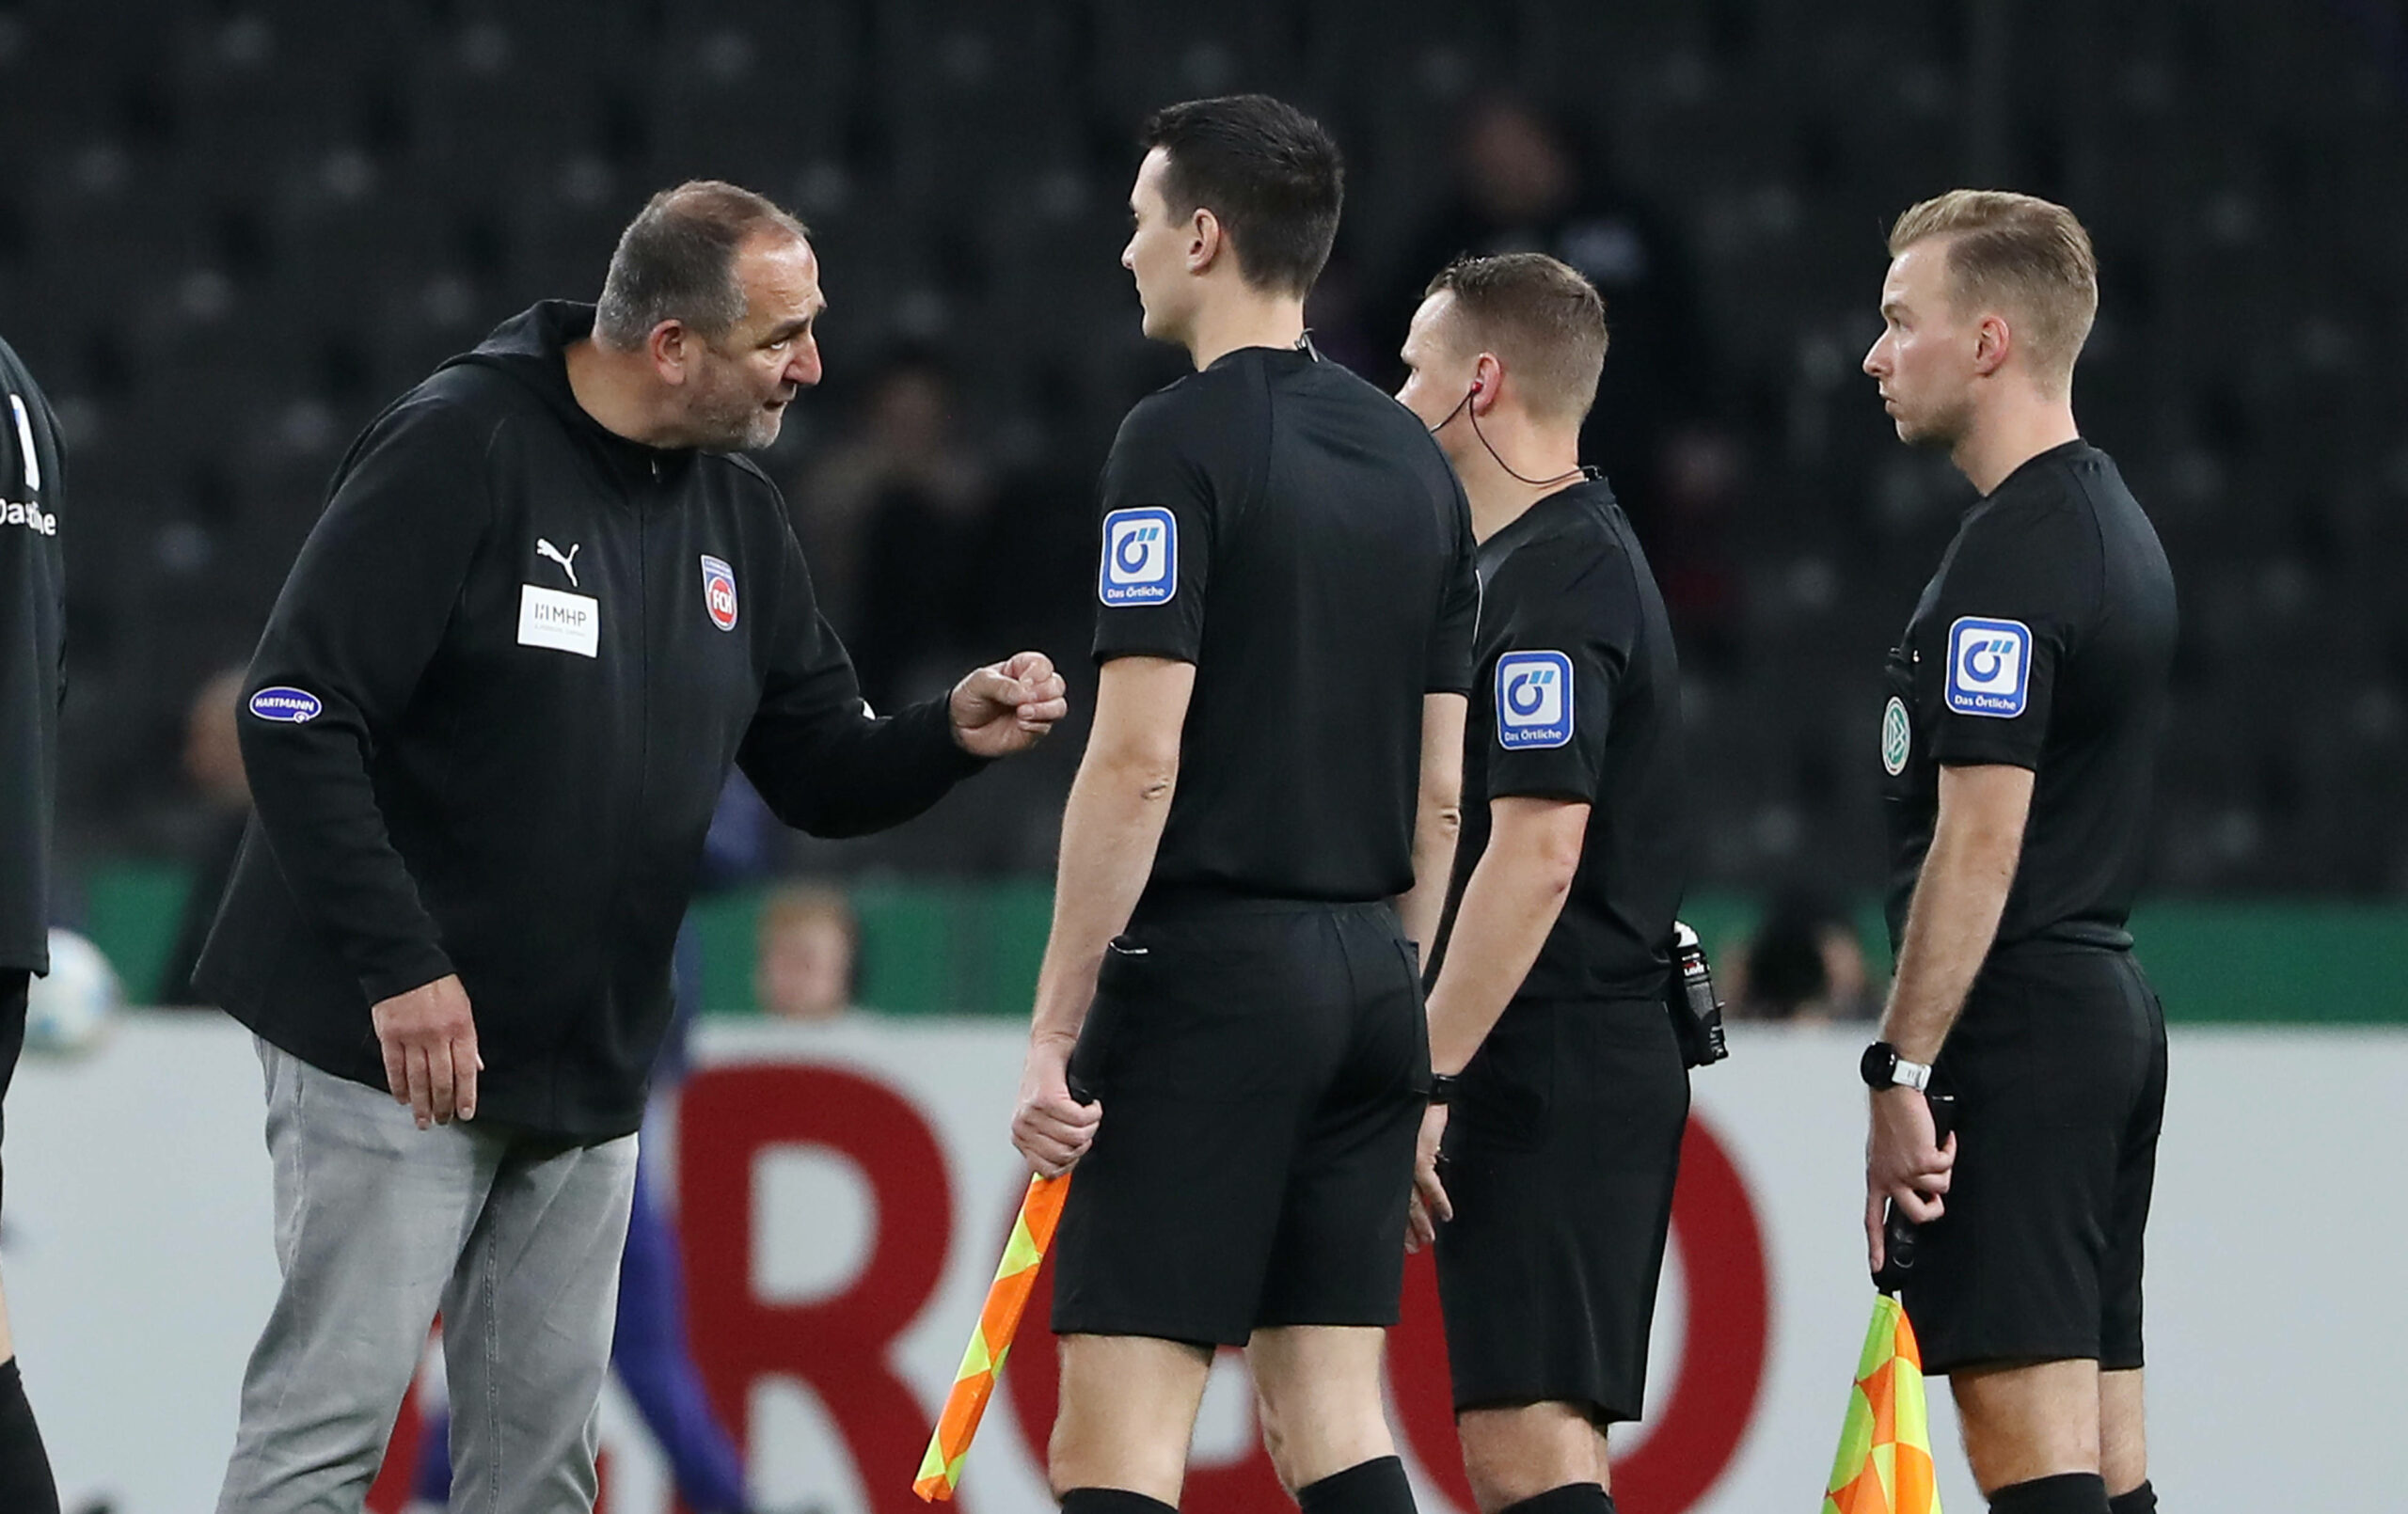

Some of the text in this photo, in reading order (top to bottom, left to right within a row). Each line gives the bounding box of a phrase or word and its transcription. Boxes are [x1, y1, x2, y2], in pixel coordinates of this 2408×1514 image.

[1107, 586, 1164, 598] Das Örtliche
[552, 606, 587, 627] MHP
[255, 697, 315, 712] HARTMANN
[1955, 694, 2017, 711] Das Örtliche
[1520, 729, 1562, 740] Örtliche
